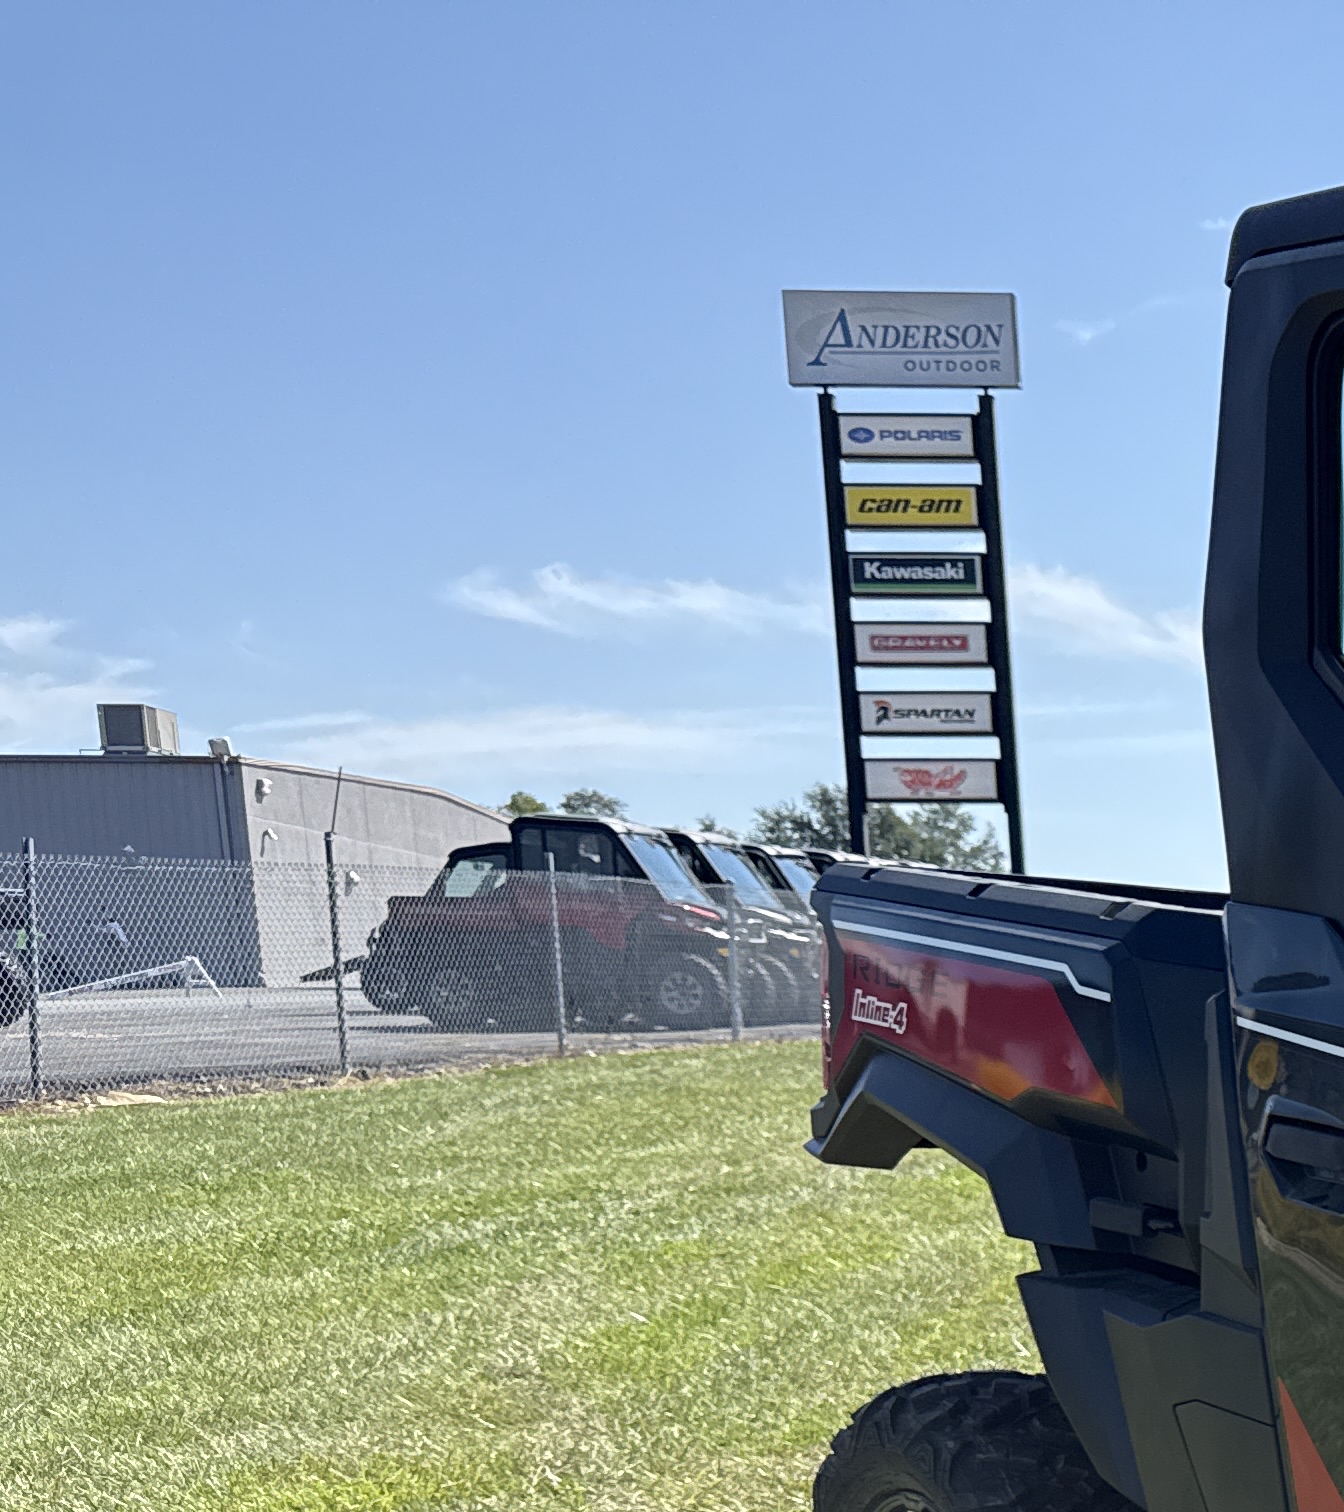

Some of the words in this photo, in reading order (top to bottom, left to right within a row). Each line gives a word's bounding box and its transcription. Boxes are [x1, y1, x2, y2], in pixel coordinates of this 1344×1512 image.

[806, 308, 1004, 366] ANDERSON
[903, 360, 1001, 372] OUTDOOR
[879, 429, 962, 441] POLARIS
[857, 498, 963, 513] can-am
[863, 561, 965, 580] Kawasaki
[892, 708, 976, 719] SPARTAN
